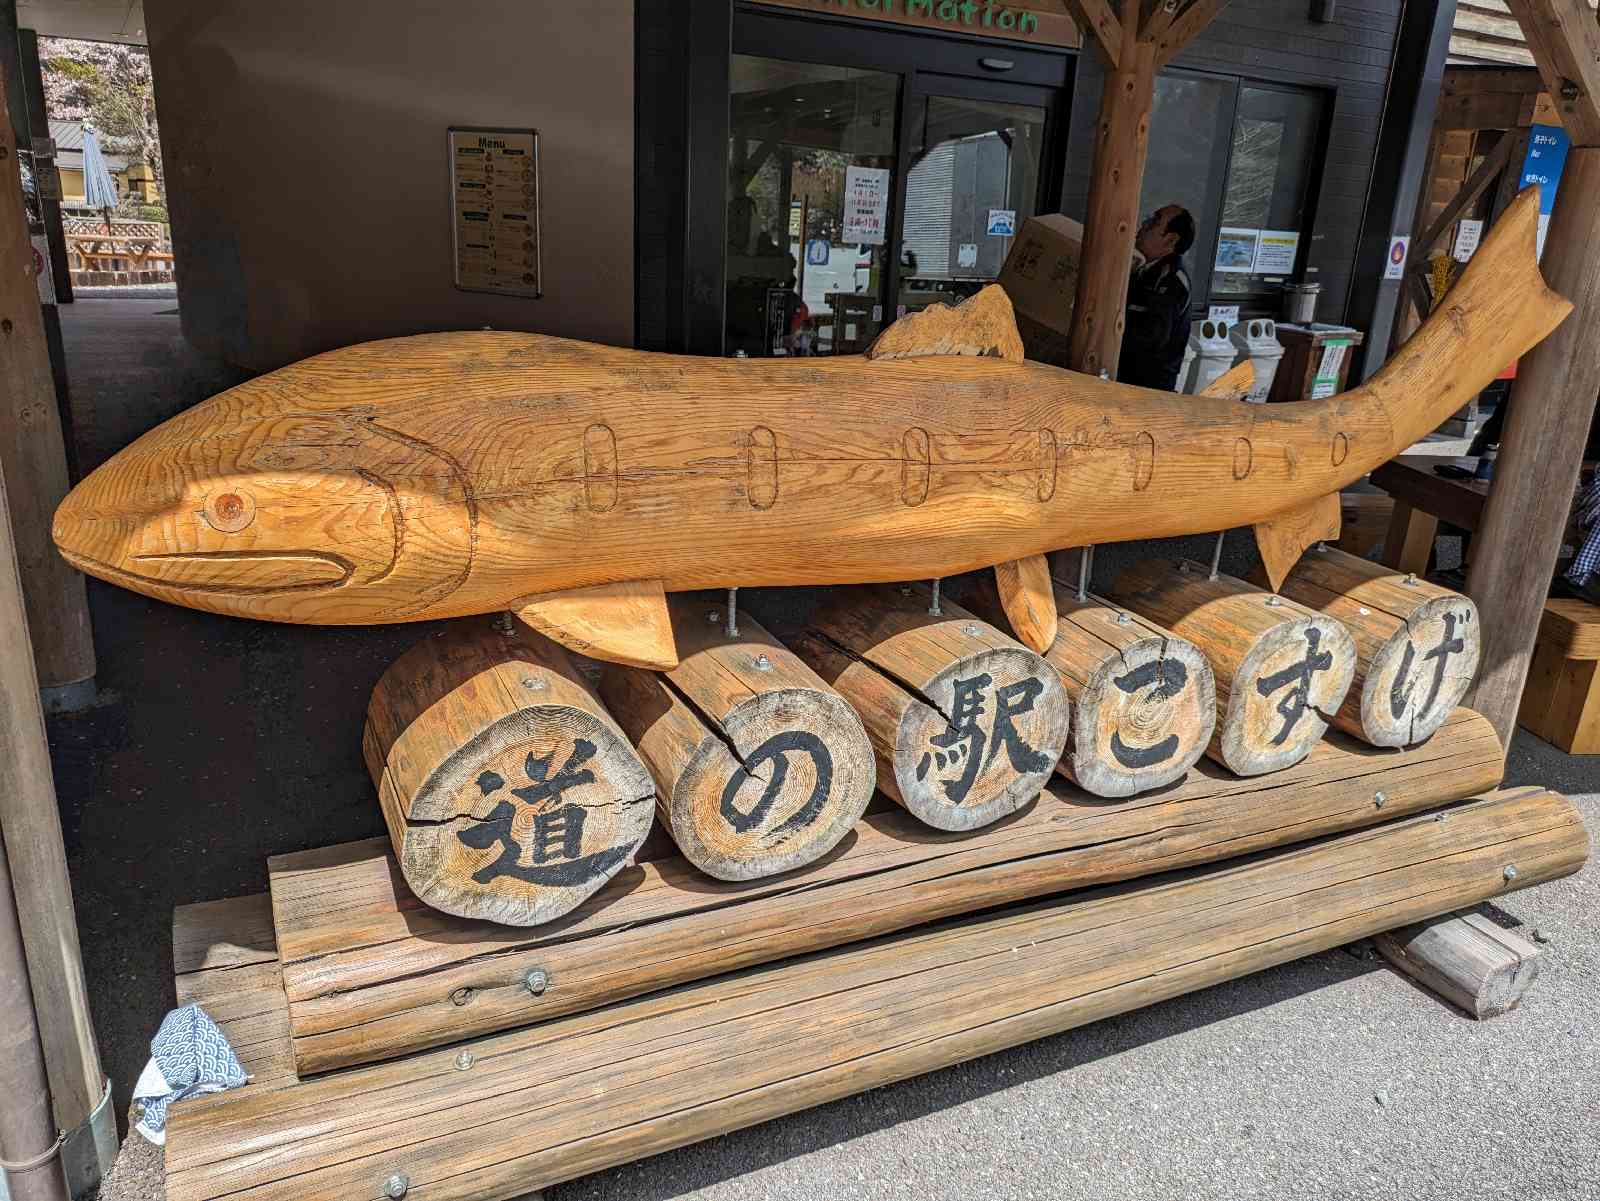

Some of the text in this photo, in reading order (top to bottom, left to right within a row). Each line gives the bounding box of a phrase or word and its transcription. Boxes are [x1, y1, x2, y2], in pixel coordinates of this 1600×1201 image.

[839, 0, 1038, 33] rmation
[479, 136, 505, 149] Menu
[456, 608, 1471, 887] 道の駅こすげ
